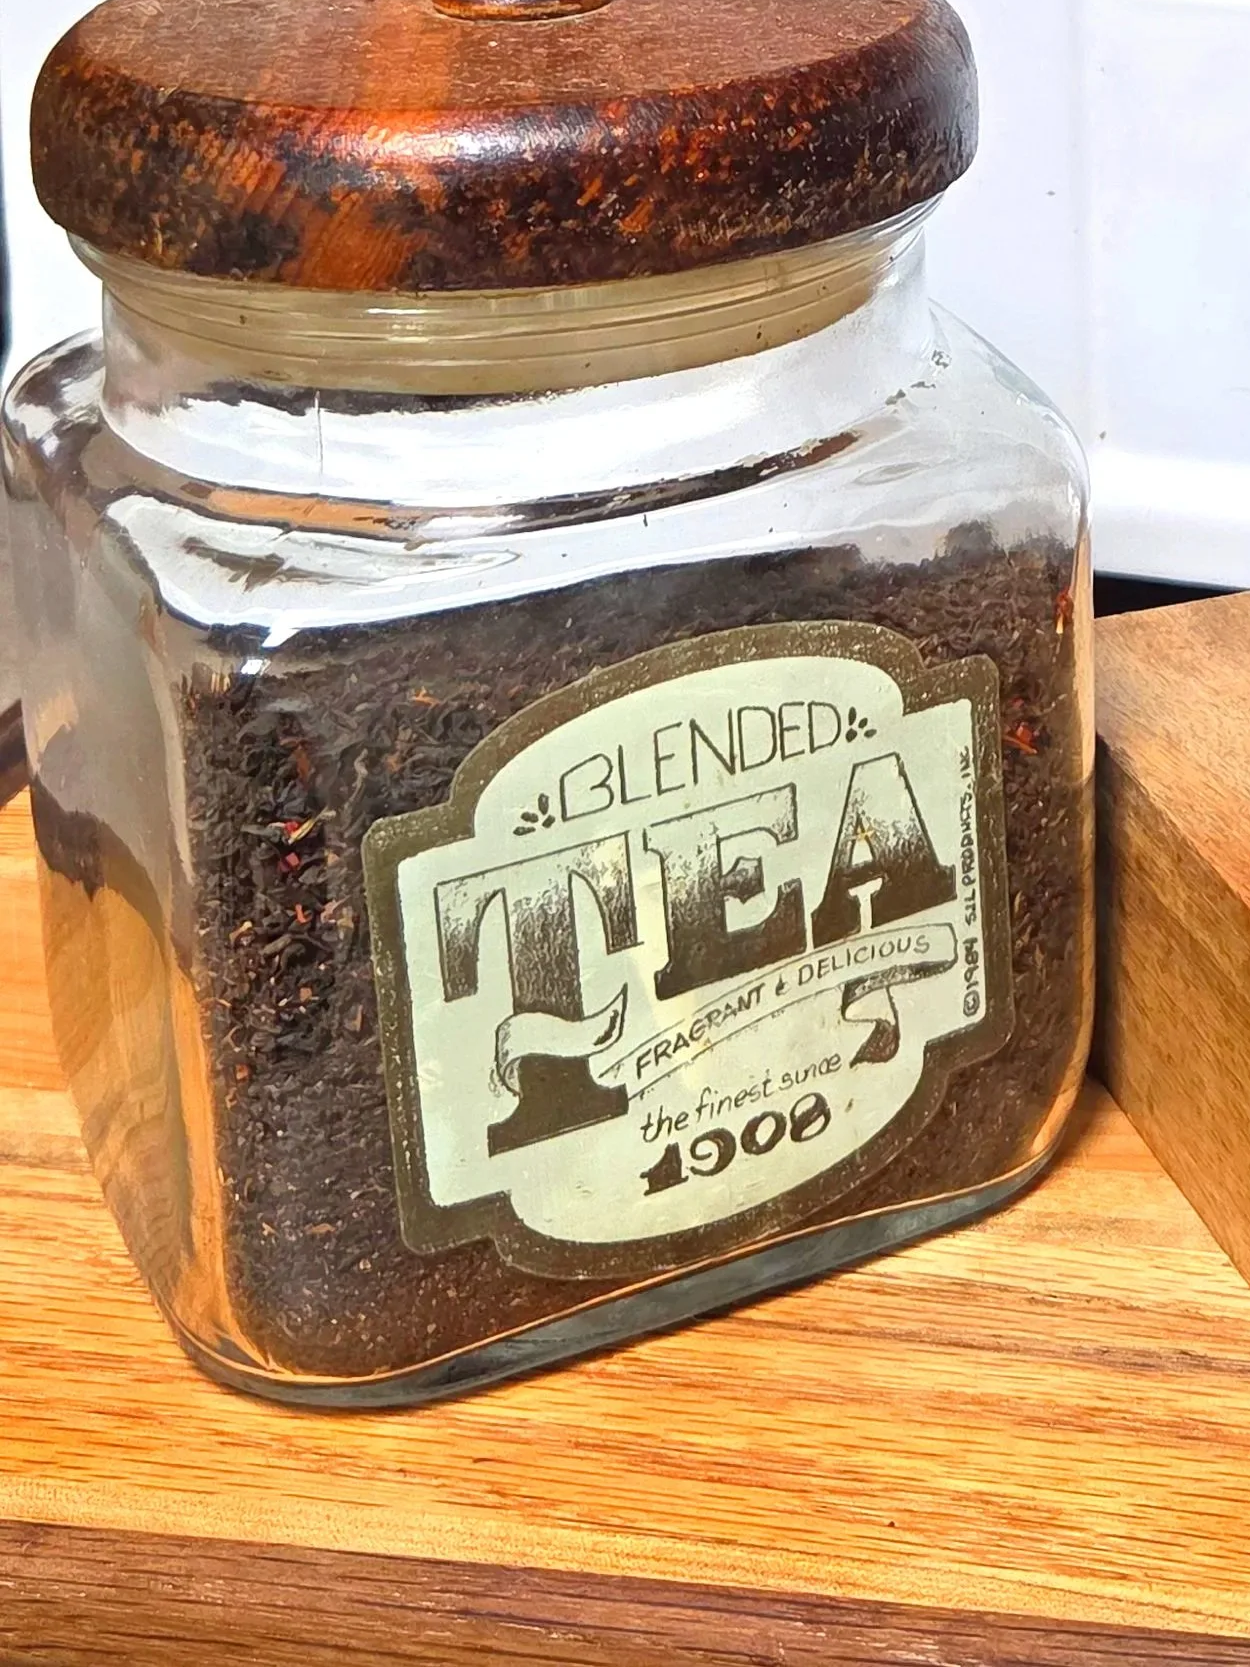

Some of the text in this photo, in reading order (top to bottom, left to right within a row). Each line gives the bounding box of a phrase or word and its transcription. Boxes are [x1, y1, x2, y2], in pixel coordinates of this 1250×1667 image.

[560, 701, 843, 823] BLENDED
[434, 751, 958, 1158] TEA
[635, 982, 765, 1080] FRAGRANT
[798, 933, 932, 987] DELICIOUS
[640, 1053, 844, 1143] the finest since
